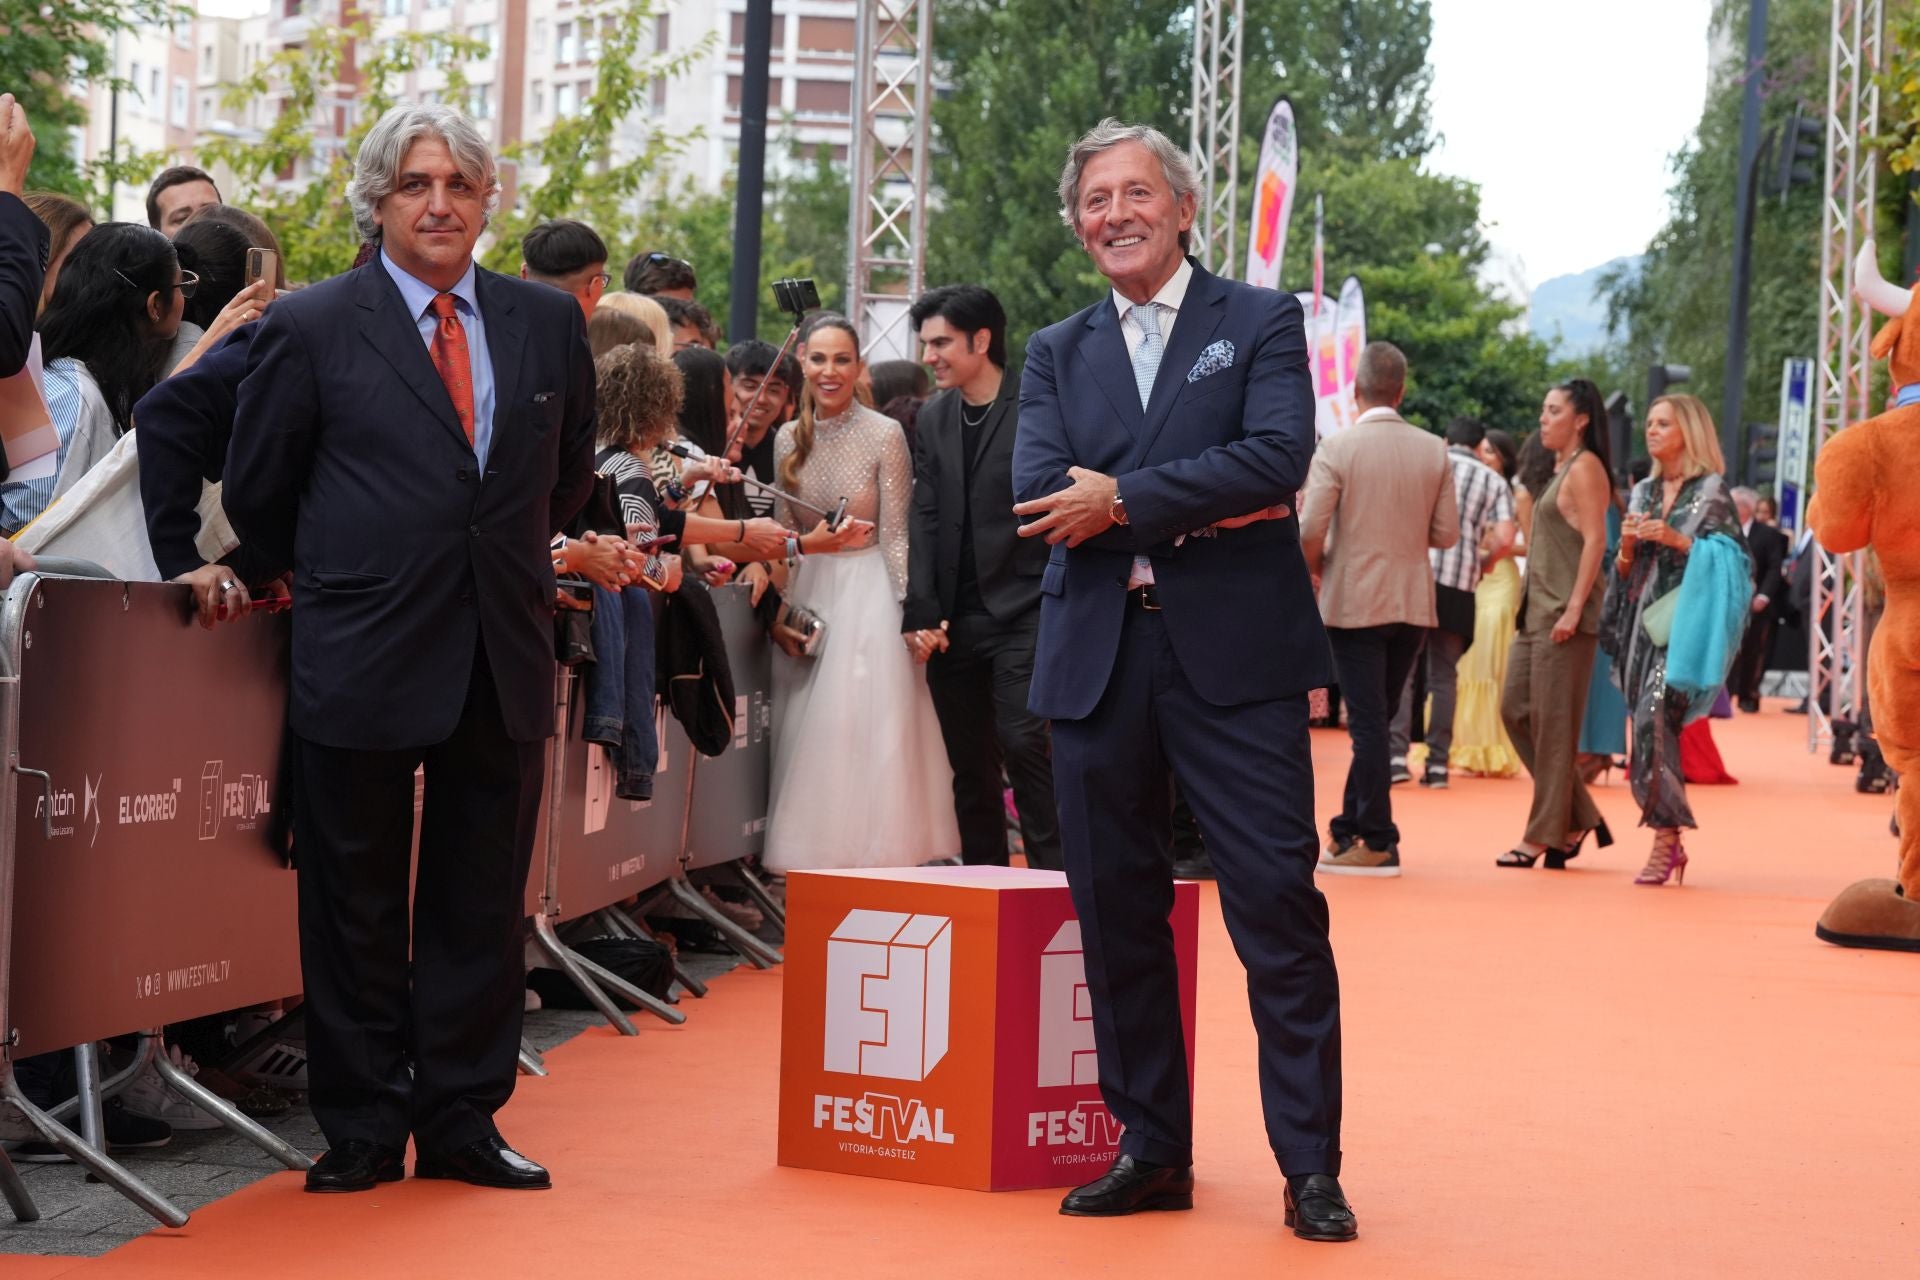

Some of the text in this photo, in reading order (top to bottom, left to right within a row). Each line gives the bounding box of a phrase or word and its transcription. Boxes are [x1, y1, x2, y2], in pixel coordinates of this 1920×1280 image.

[118, 792, 177, 824] EL CORREO
[222, 773, 271, 819] FESTVAL
[167, 959, 231, 993] WWW.FESTVAL.TV
[813, 1091, 955, 1145] FESTVAL
[1027, 1100, 1127, 1147] FESTV
[838, 1141, 917, 1161] VITORIA-GASTEIZ
[1052, 1150, 1120, 1166] VITORIA-GASTE
